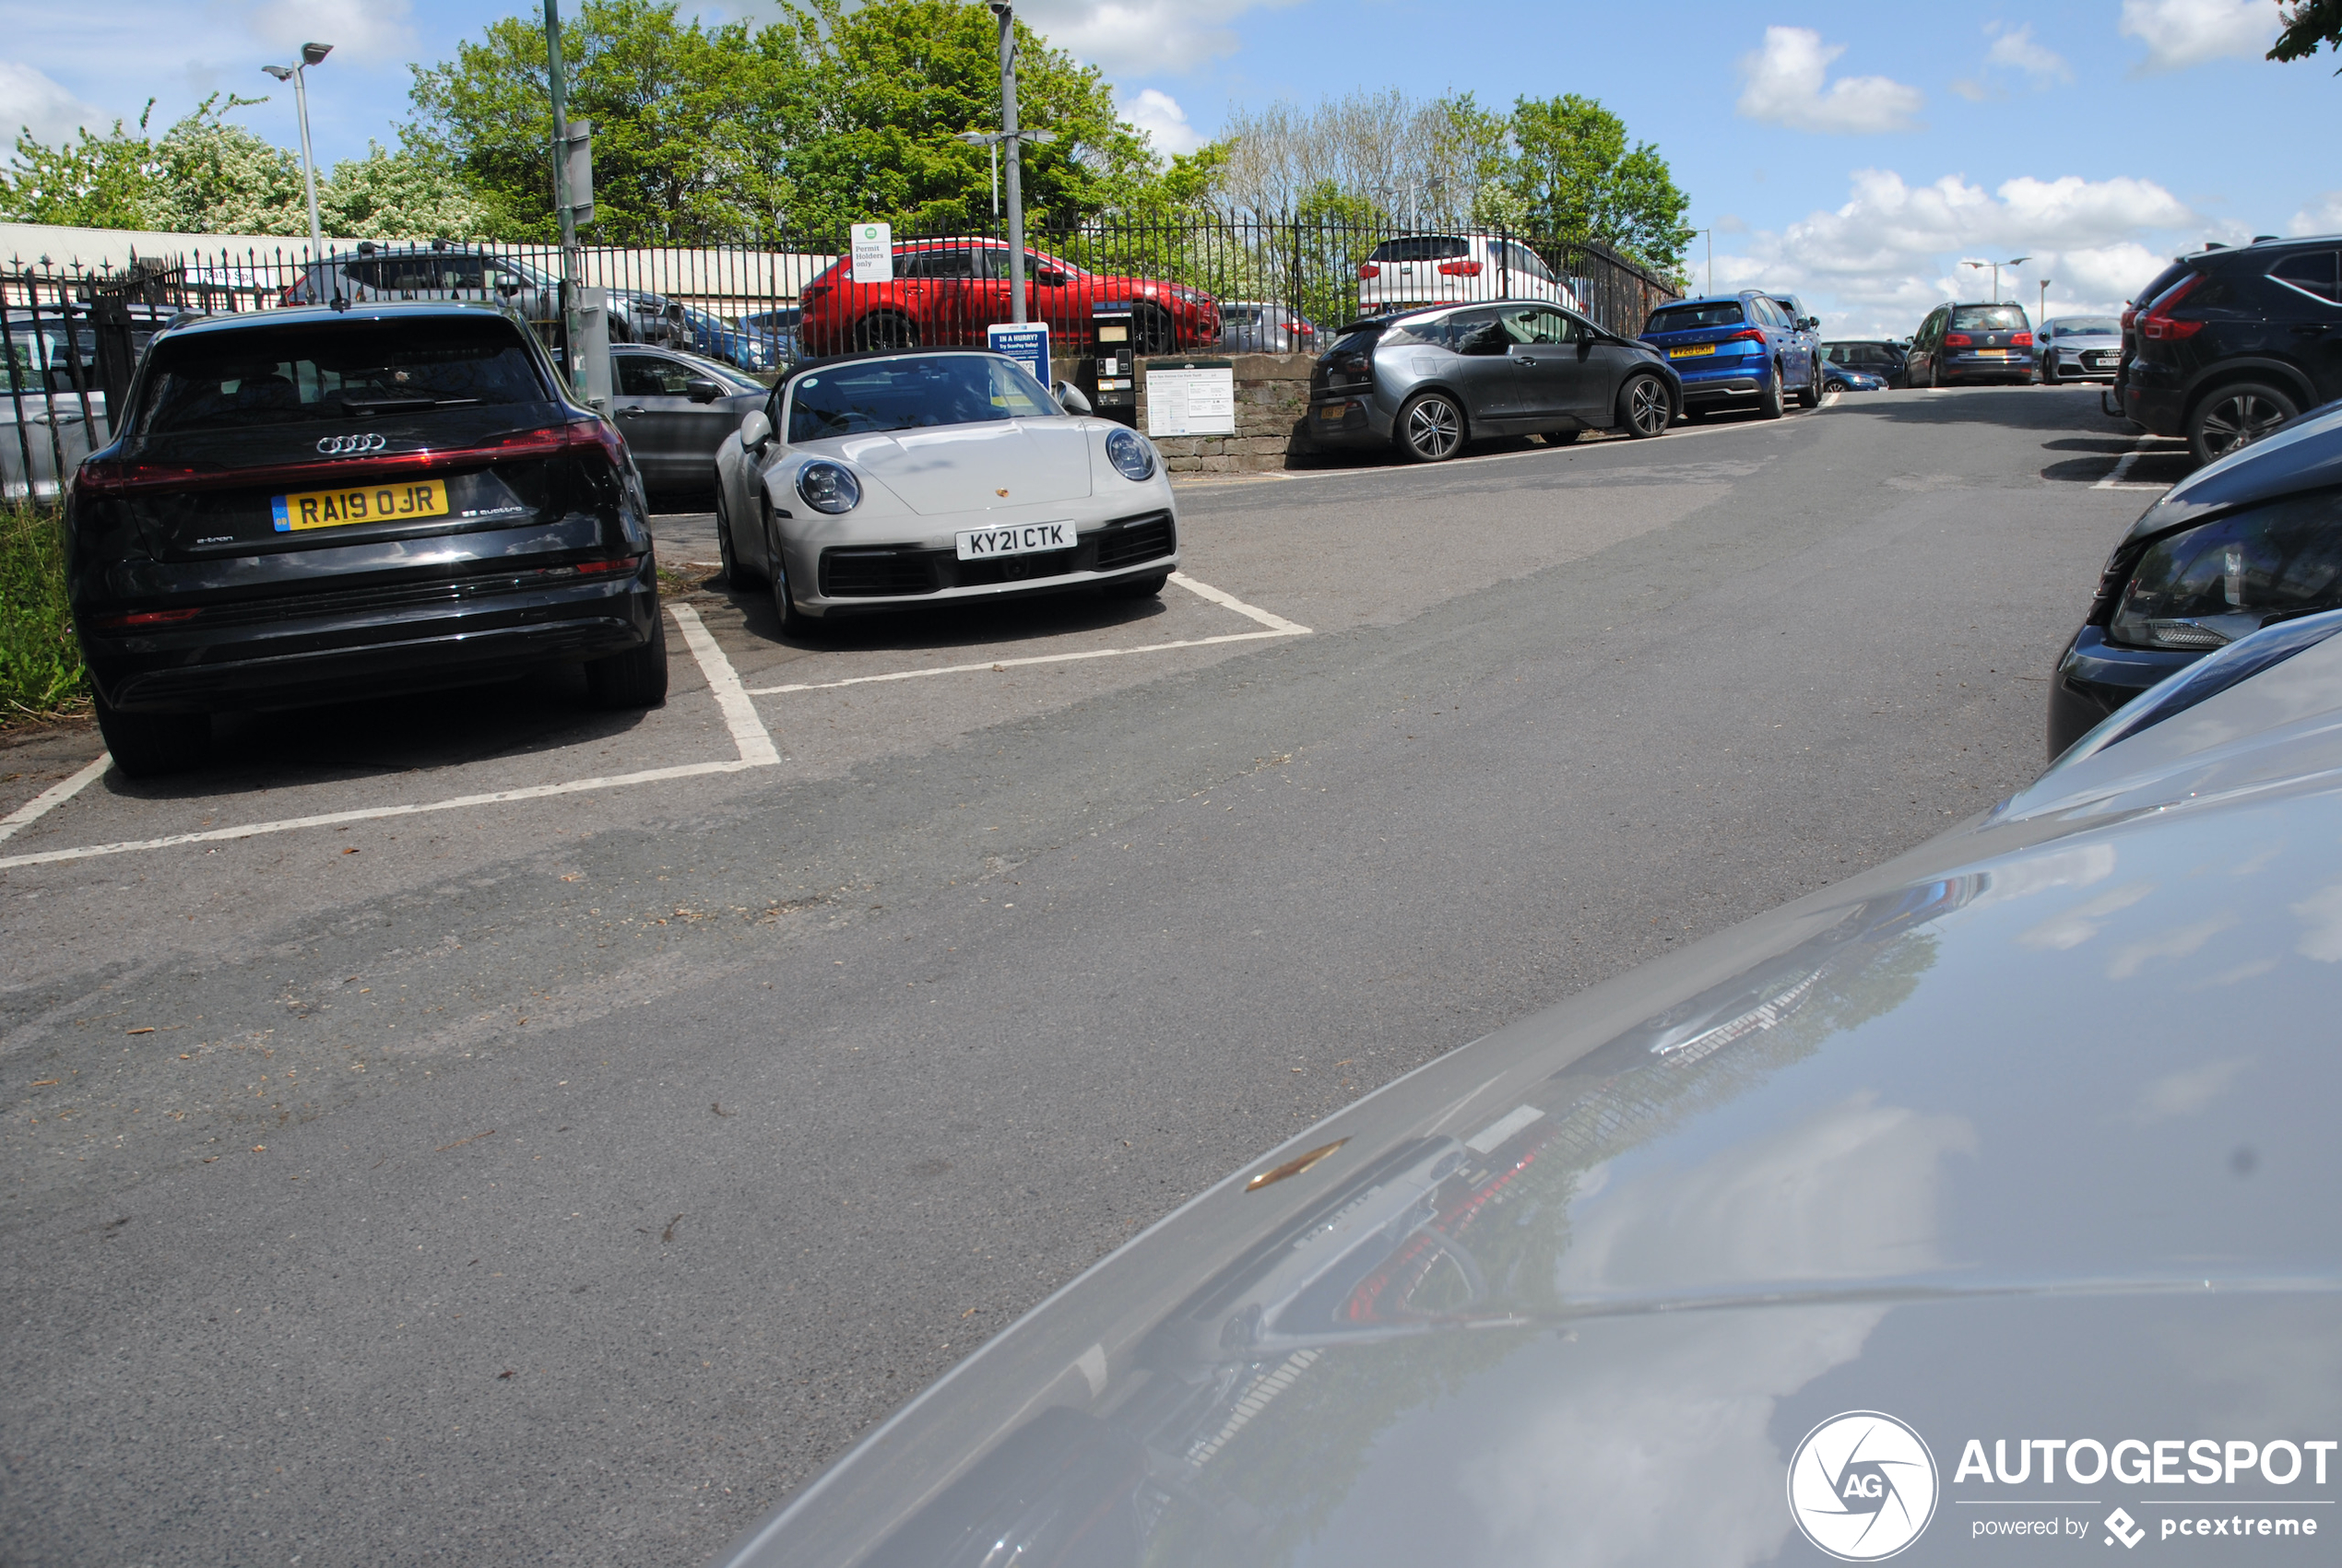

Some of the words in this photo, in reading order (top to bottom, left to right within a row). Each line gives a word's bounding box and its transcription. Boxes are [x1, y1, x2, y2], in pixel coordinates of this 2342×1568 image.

[205, 268, 231, 279] Bath
[234, 270, 254, 282] Spa
[299, 492, 368, 525] RA19
[376, 486, 434, 516] OJR
[479, 506, 523, 516] quattro
[276, 516, 288, 526] GB
[196, 536, 233, 544] e-tron
[970, 530, 1018, 554] KY21
[1023, 525, 1063, 548] CTK
